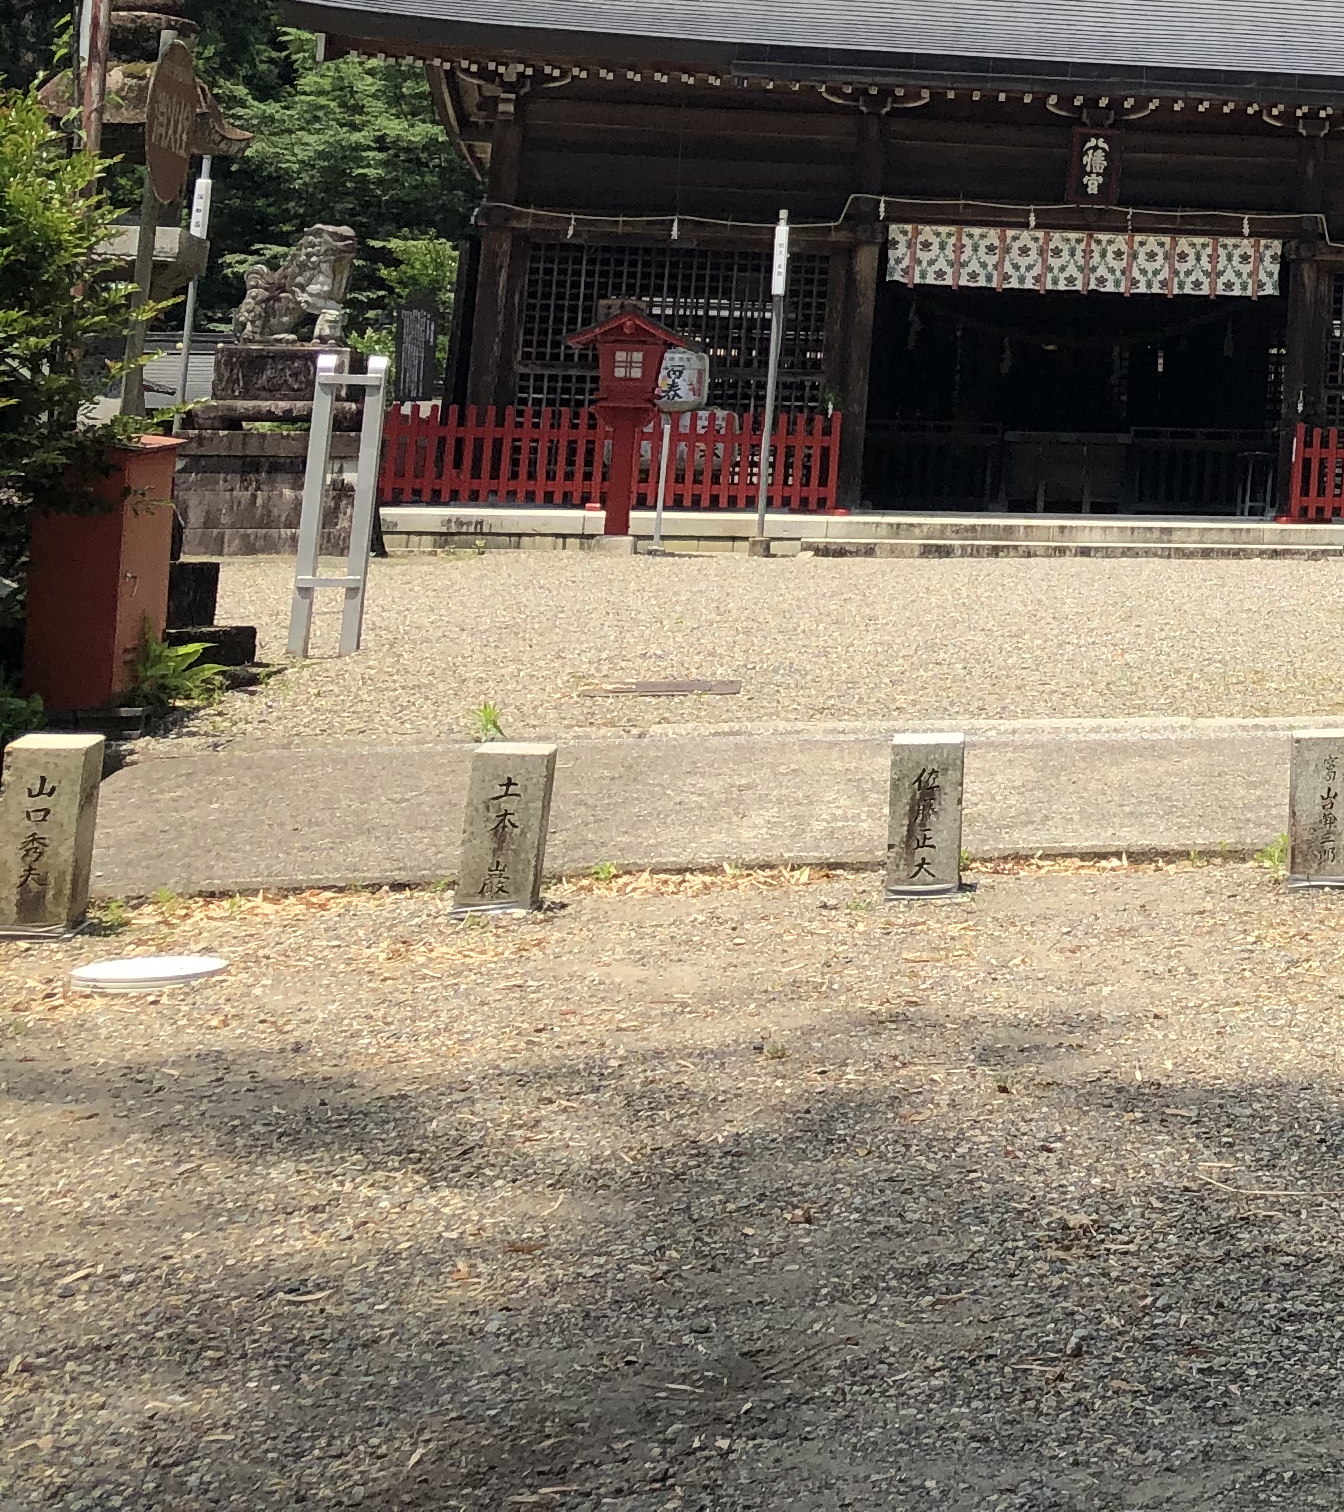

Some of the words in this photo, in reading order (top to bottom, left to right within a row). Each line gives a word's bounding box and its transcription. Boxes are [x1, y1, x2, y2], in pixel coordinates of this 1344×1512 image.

[1082, 137, 1110, 195] 八幡宮
[16, 775, 58, 889] 山口秀夫
